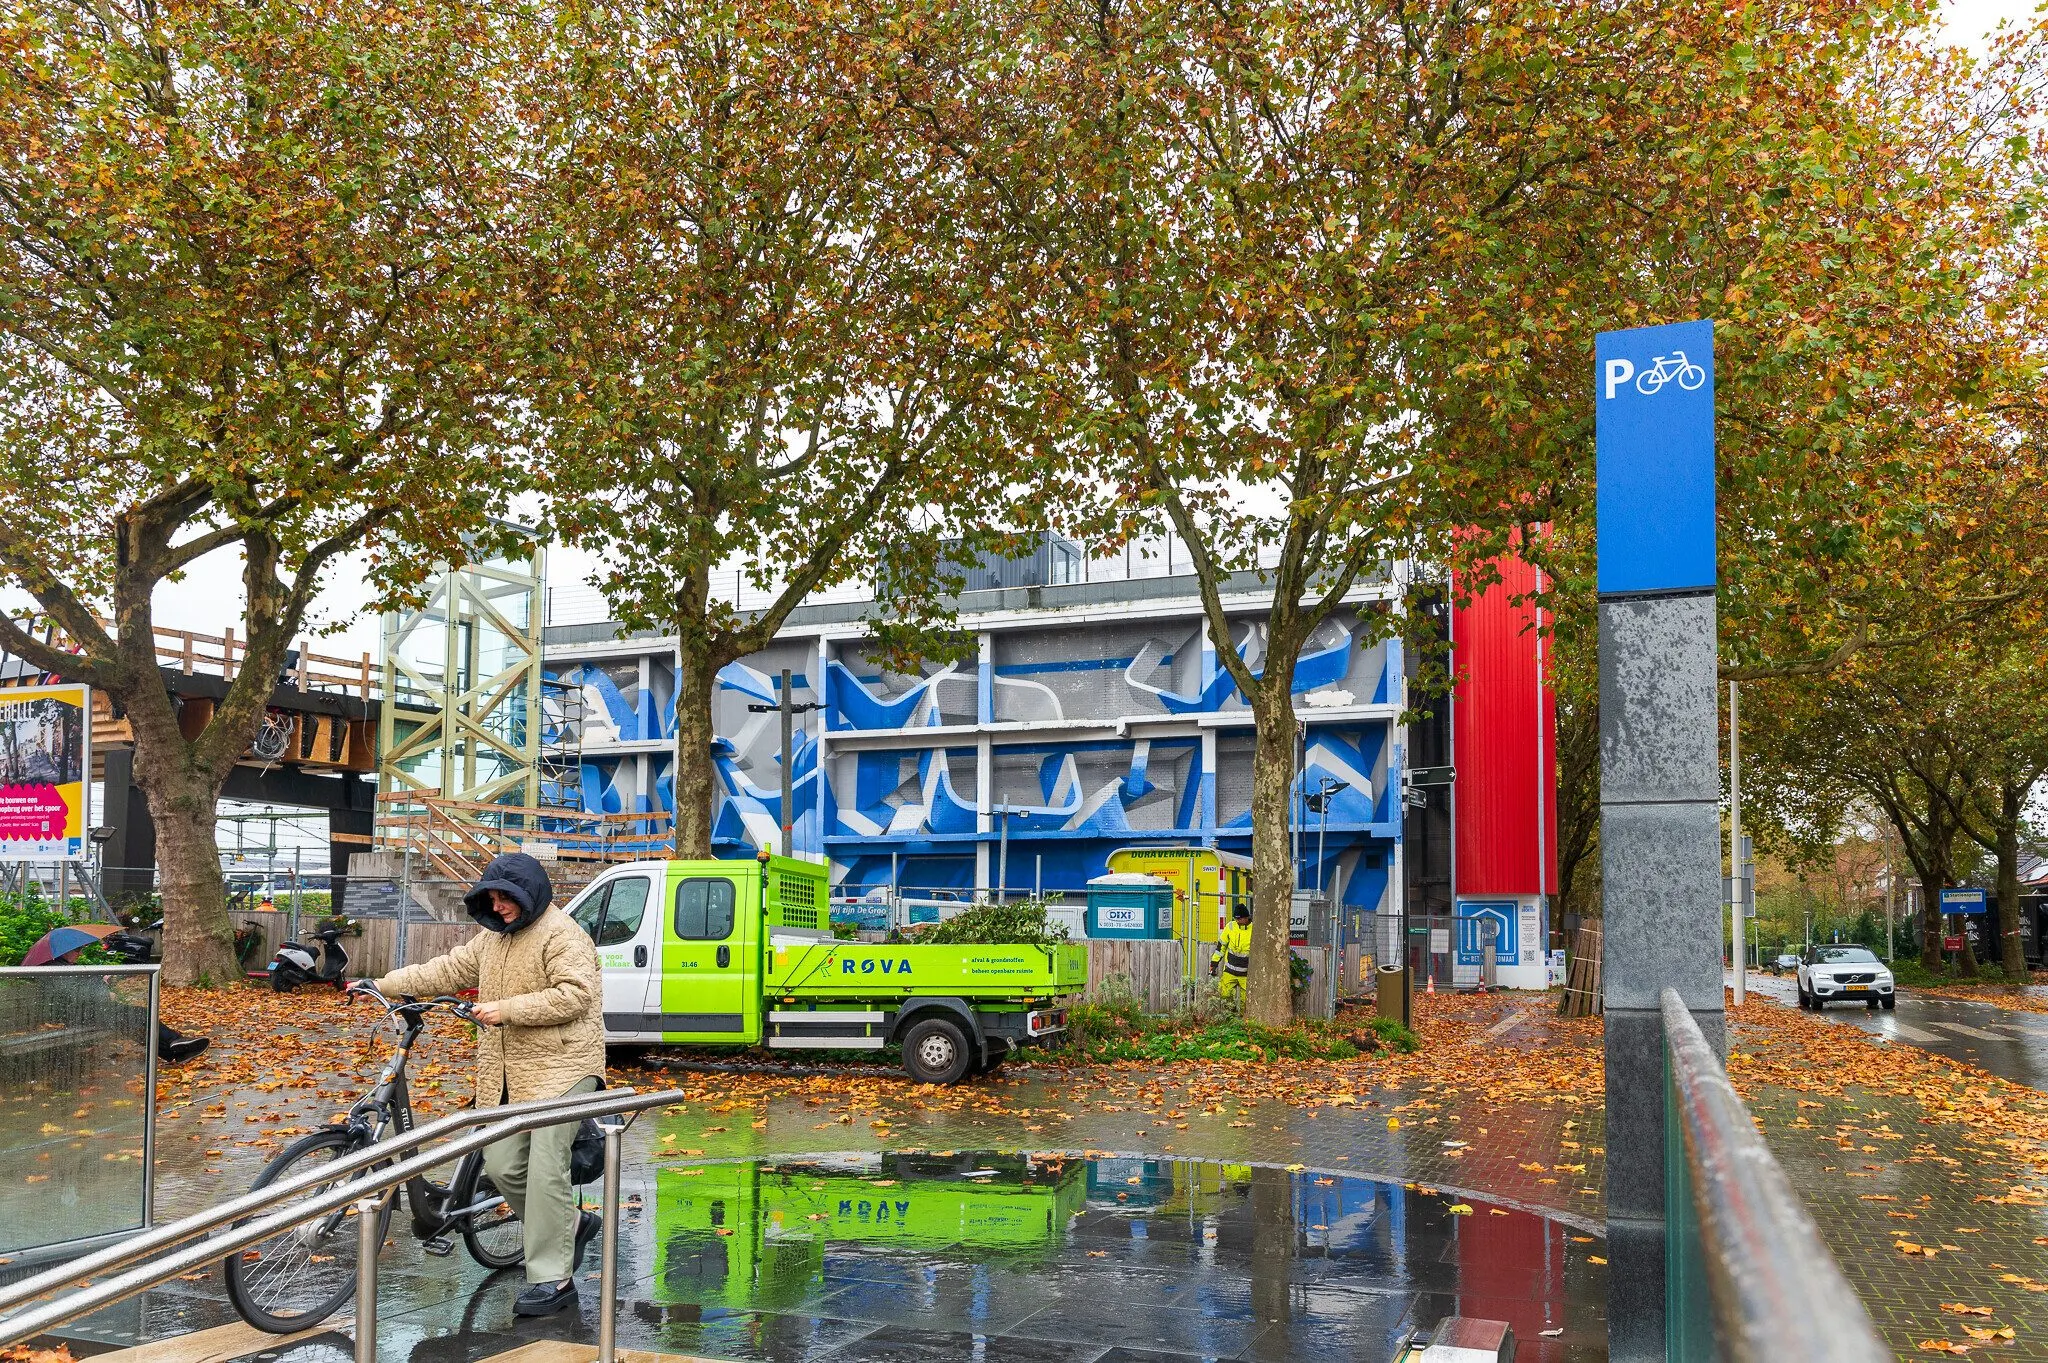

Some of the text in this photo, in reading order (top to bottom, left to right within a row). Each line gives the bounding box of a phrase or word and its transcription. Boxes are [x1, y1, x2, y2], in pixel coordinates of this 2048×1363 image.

[1605, 359, 1635, 400] P
[842, 904, 855, 915] zijn
[857, 905, 868, 914] De
[991, 957, 1025, 965] grondstoffen
[990, 968, 1014, 976] openbare
